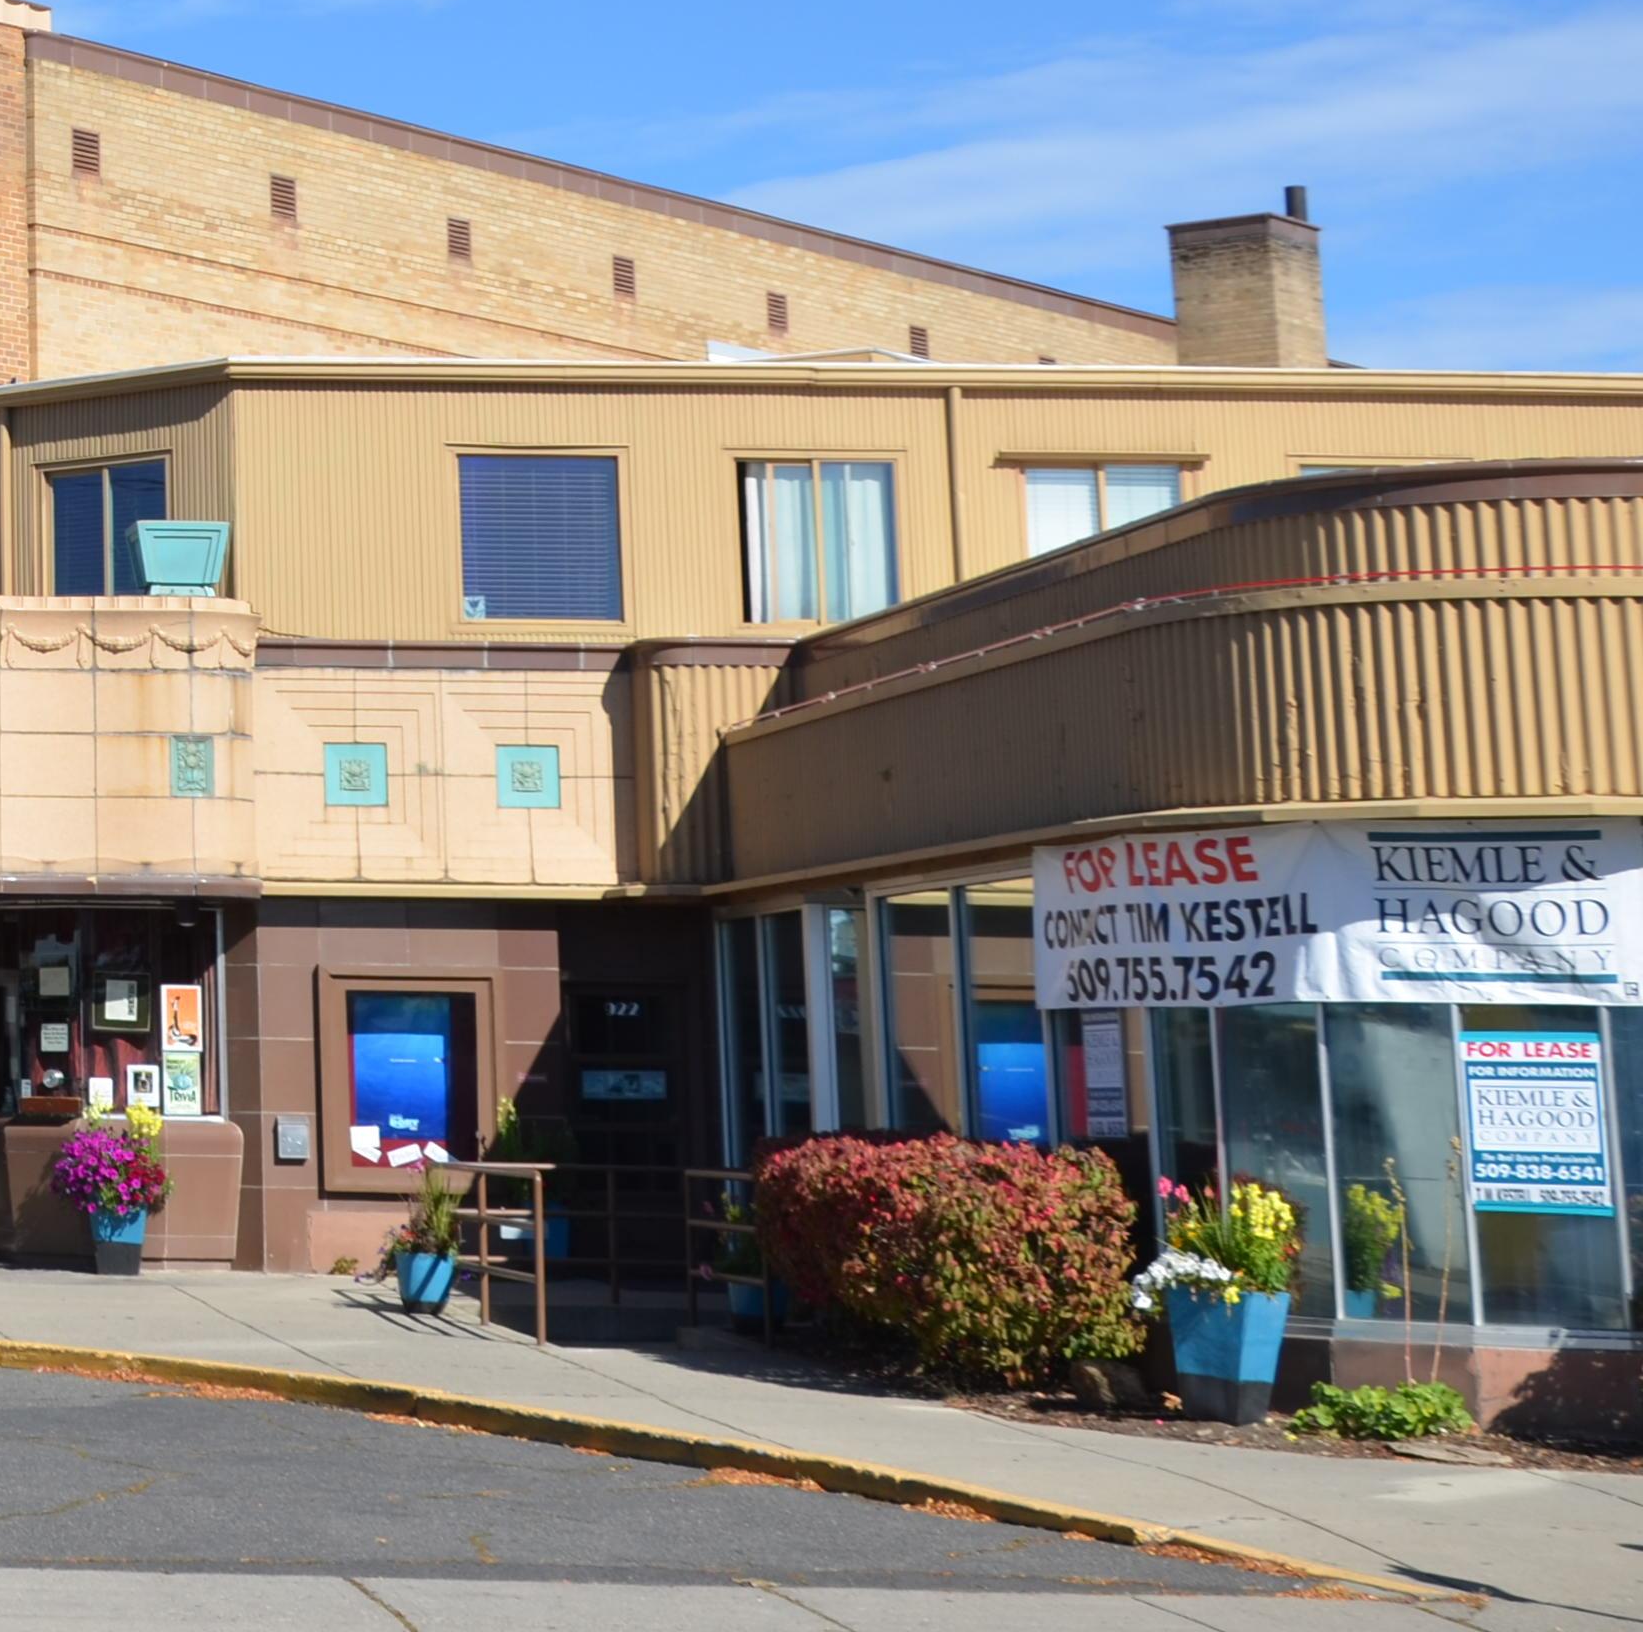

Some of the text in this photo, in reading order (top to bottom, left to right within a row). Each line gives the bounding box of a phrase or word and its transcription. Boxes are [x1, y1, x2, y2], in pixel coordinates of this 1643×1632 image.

[1063, 836, 1259, 894] FOR LEASE
[1370, 844, 1606, 884] KIEMLE &
[1125, 902, 1170, 943] TIM
[1180, 892, 1318, 943] KESTELL
[1373, 897, 1610, 937] HAGOOD
[1377, 947, 1612, 971] COMPANY
[1467, 1041, 1592, 1058] FOR LEASE
[1468, 1065, 1596, 1078] FOR INFORMATION
[1477, 1089, 1564, 1106] KIEMLE
[1478, 1109, 1595, 1128] HAGOOD
[1474, 1162, 1604, 1182] 509-838-6541
